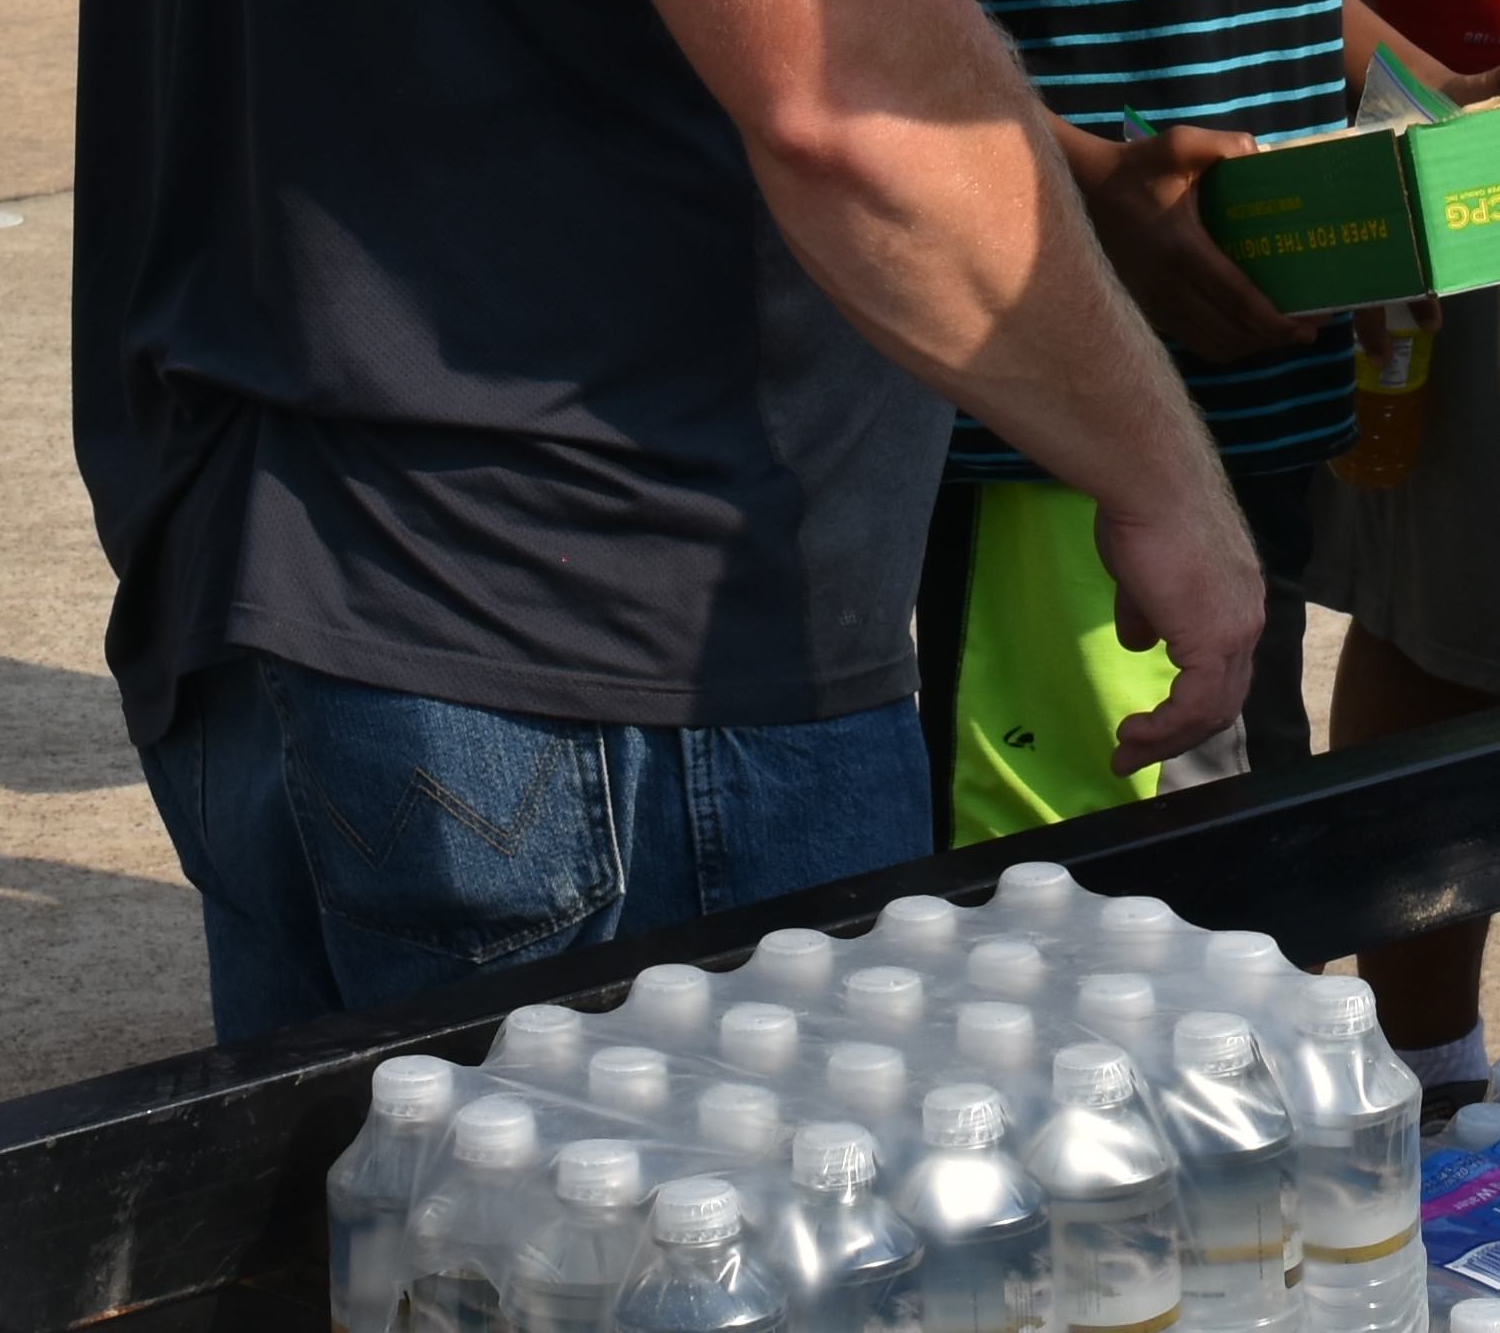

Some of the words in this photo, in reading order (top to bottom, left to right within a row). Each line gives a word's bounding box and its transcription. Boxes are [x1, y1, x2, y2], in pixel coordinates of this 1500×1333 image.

[1275, 231, 1304, 254] THE
[1308, 225, 1337, 249] FOR
[1341, 218, 1388, 245] PAPER
